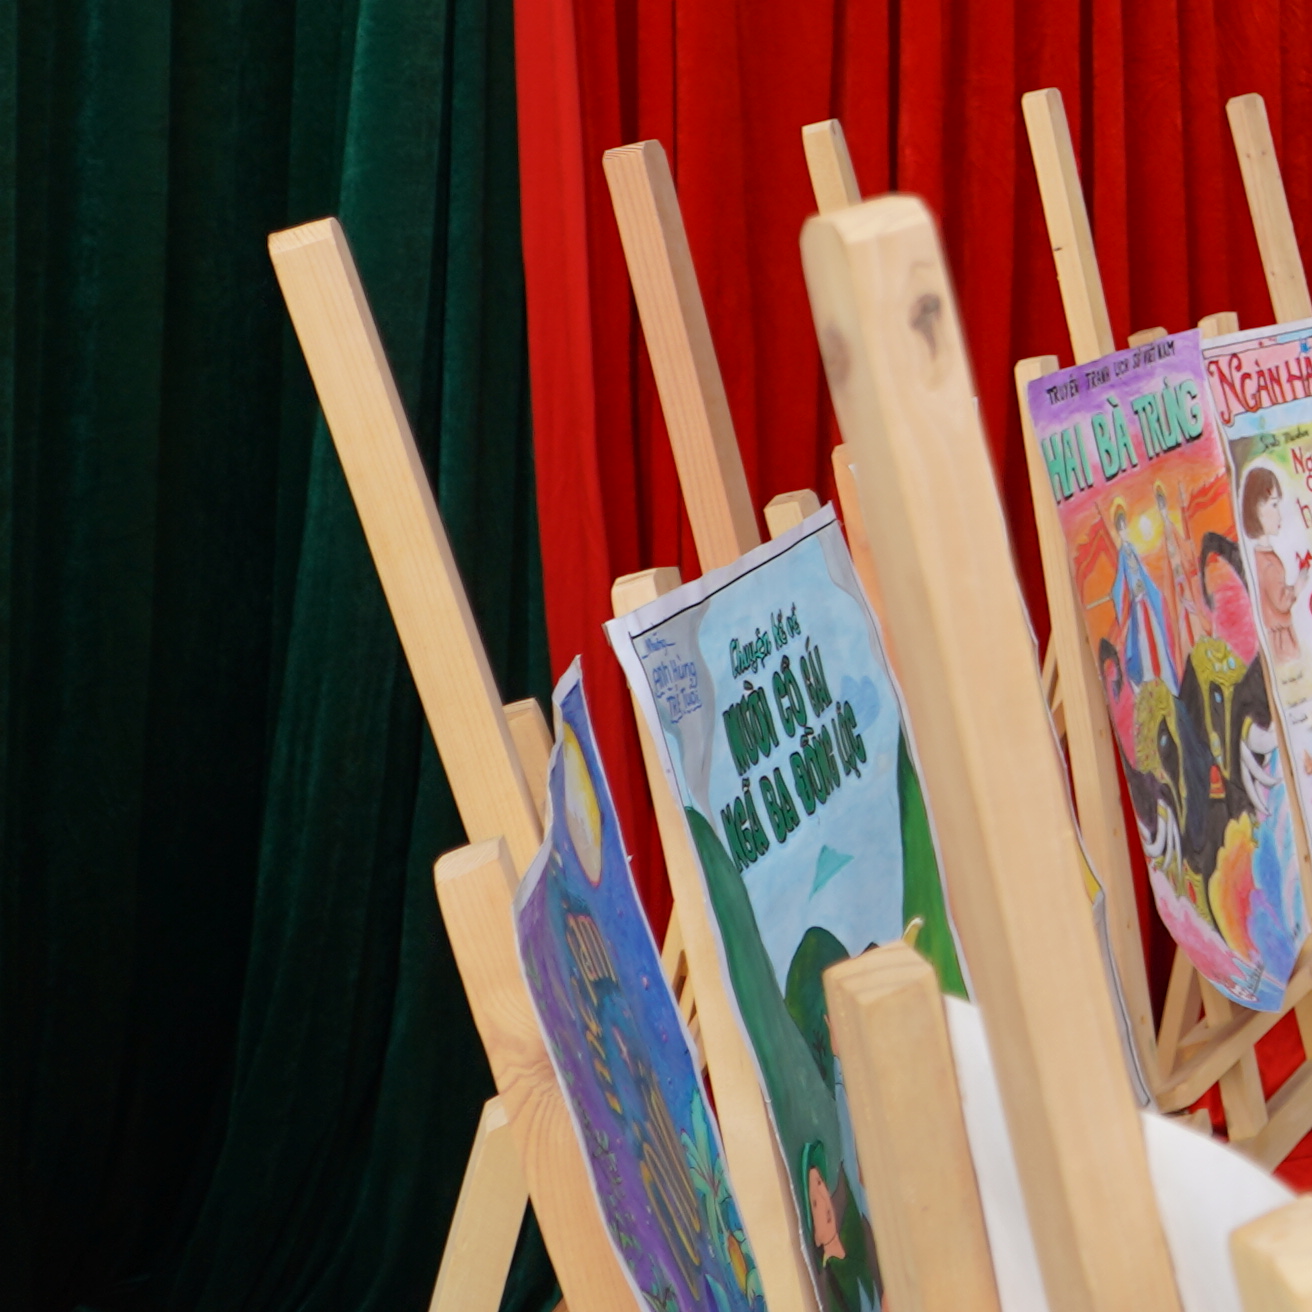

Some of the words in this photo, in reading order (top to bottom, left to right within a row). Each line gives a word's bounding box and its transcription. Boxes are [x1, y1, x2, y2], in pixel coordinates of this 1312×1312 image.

[1207, 353, 1285, 426] NGÀN
[1041, 423, 1093, 505] HAI
[1092, 395, 1138, 482] BÀ
[772, 654, 807, 738] CÔ
[759, 766, 800, 844] BA
